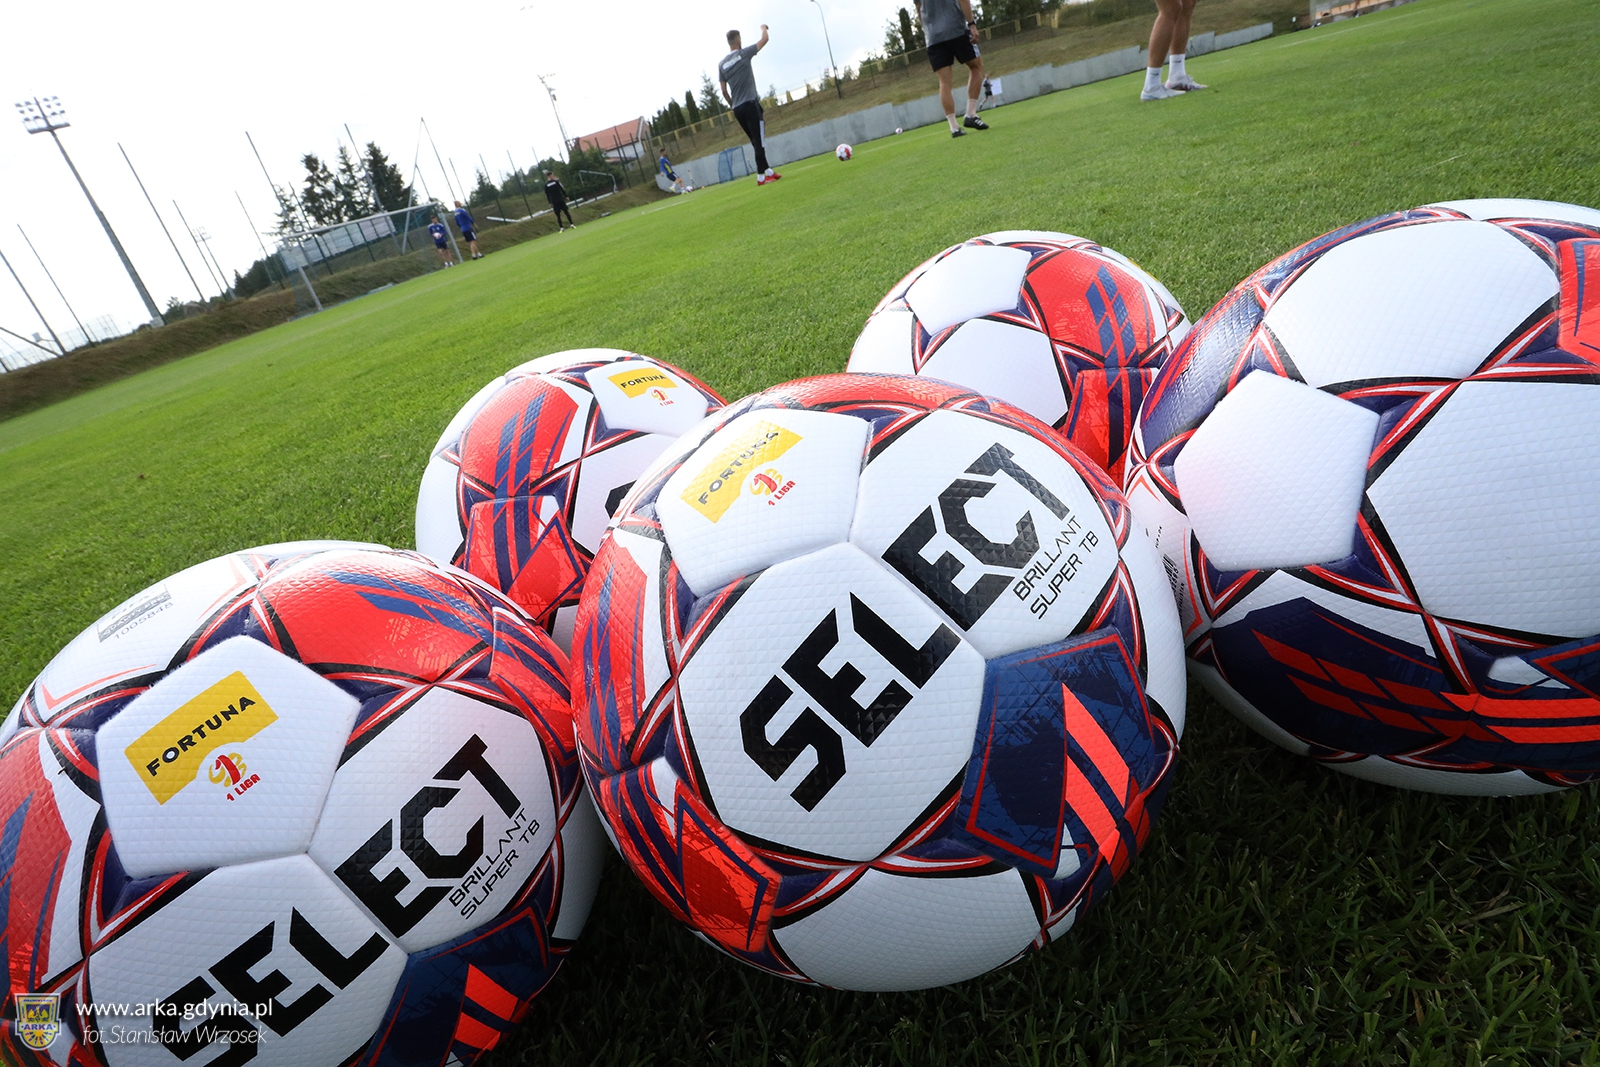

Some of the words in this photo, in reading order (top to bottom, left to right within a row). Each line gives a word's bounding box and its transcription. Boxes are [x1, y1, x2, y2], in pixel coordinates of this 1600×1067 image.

[620, 374, 667, 388] FORTUNA
[698, 432, 779, 505] FORTUNA
[773, 480, 796, 500] LIGA
[1012, 515, 1082, 602] BRILLANT
[1030, 553, 1083, 620] SUPER
[1078, 530, 1099, 553] TB
[739, 442, 1071, 813] SELECT
[146, 696, 256, 777] FORTUNA
[226, 793, 235, 801] 1
[234, 773, 261, 796] LIGA
[152, 733, 522, 1067] SELECT
[448, 808, 527, 907] BRILLANT
[460, 849, 520, 920] SUPER
[518, 819, 540, 844] TB
